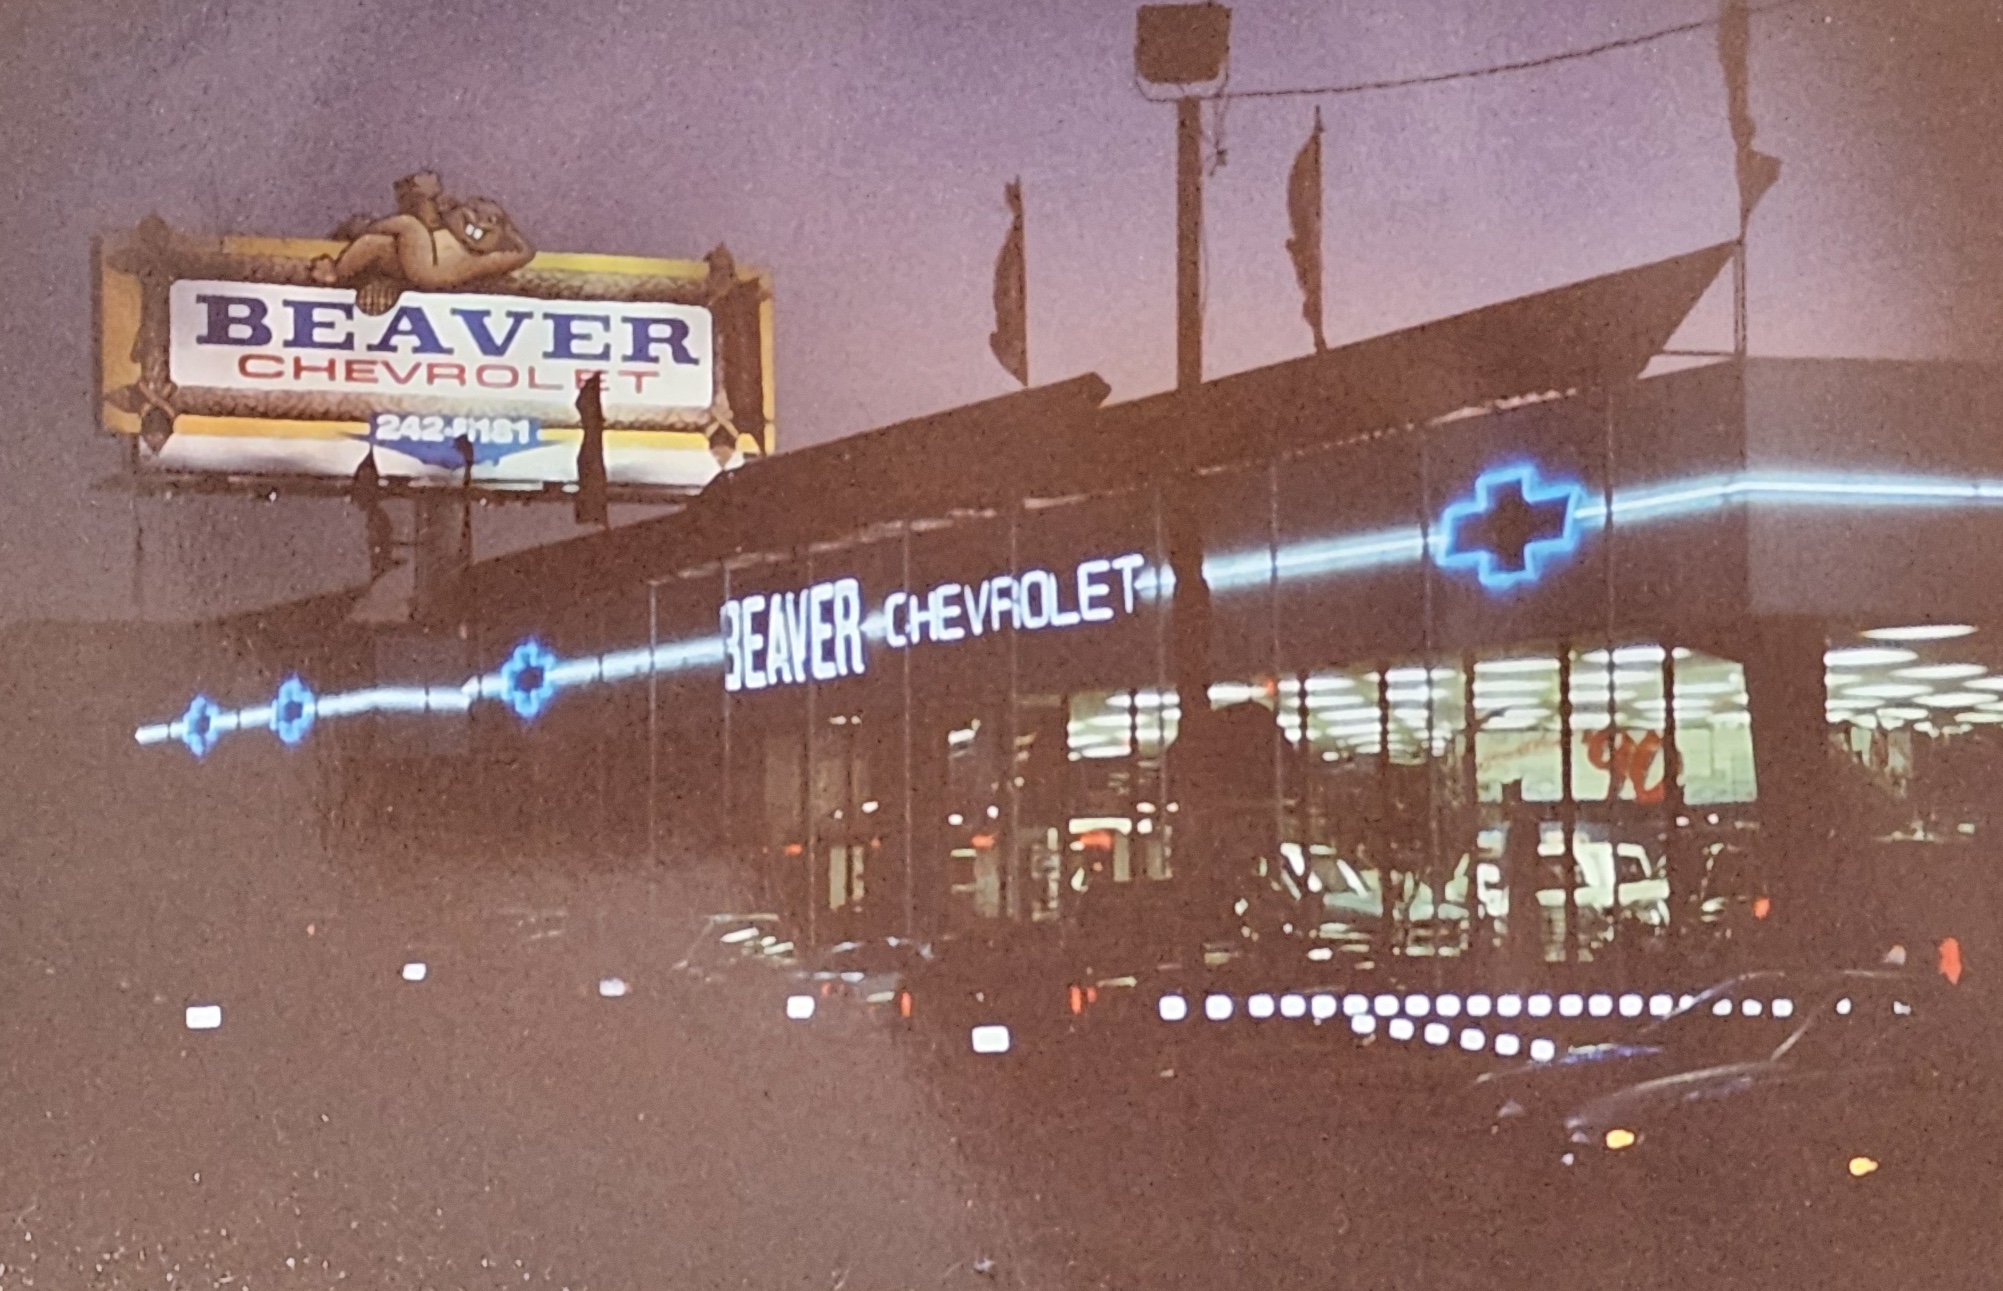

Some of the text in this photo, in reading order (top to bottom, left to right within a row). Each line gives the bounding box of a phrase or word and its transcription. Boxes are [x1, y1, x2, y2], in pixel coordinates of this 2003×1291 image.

[196, 293, 700, 365] BEAVER
[719, 553, 1145, 692] BEAVER CHEVROLET
